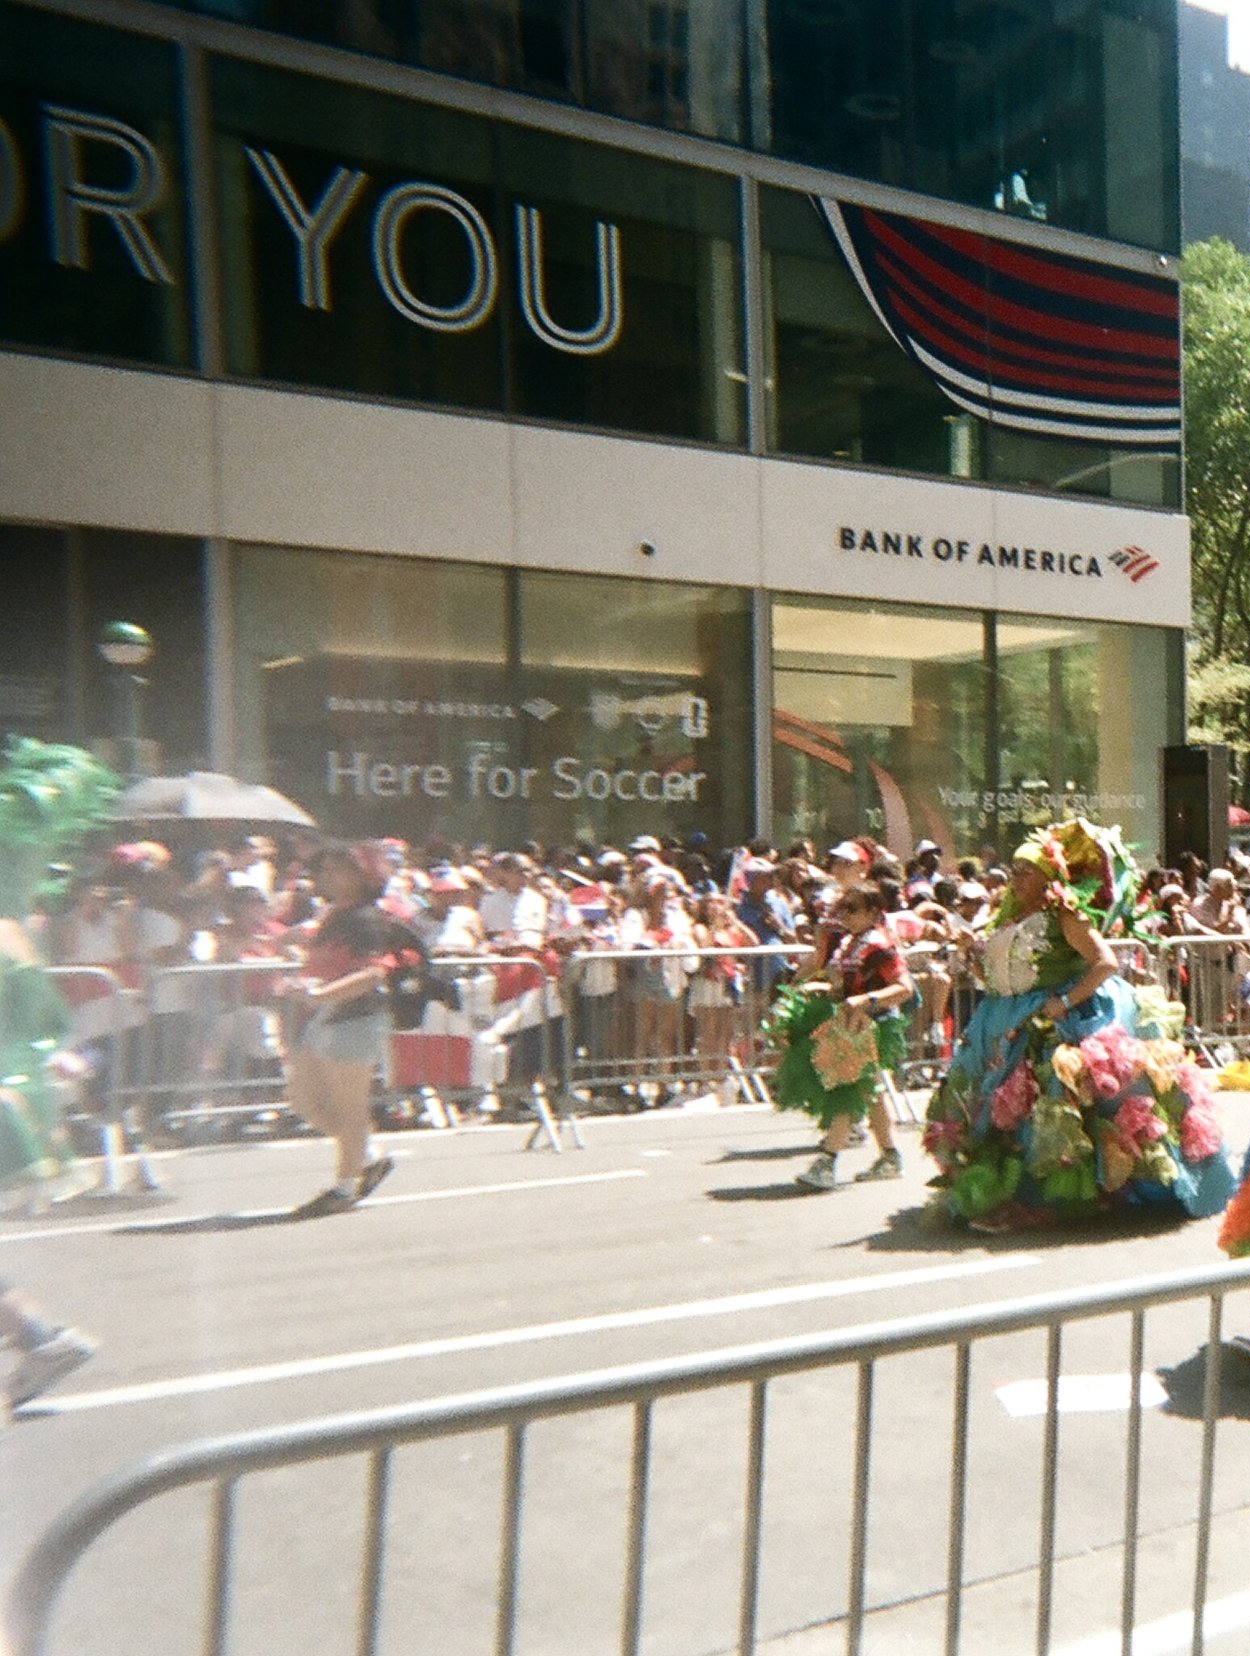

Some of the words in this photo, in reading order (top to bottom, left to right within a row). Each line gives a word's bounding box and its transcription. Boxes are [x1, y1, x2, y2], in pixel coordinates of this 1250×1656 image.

[0, 103, 176, 286] R
[243, 146, 624, 356] YOU
[839, 526, 923, 558] BANK
[932, 538, 971, 562] OF
[977, 544, 1103, 578] AMERICA
[424, 700, 517, 719] AMERICA
[326, 750, 452, 798] Here
[467, 751, 539, 799] for
[553, 756, 708, 802] Soccer
